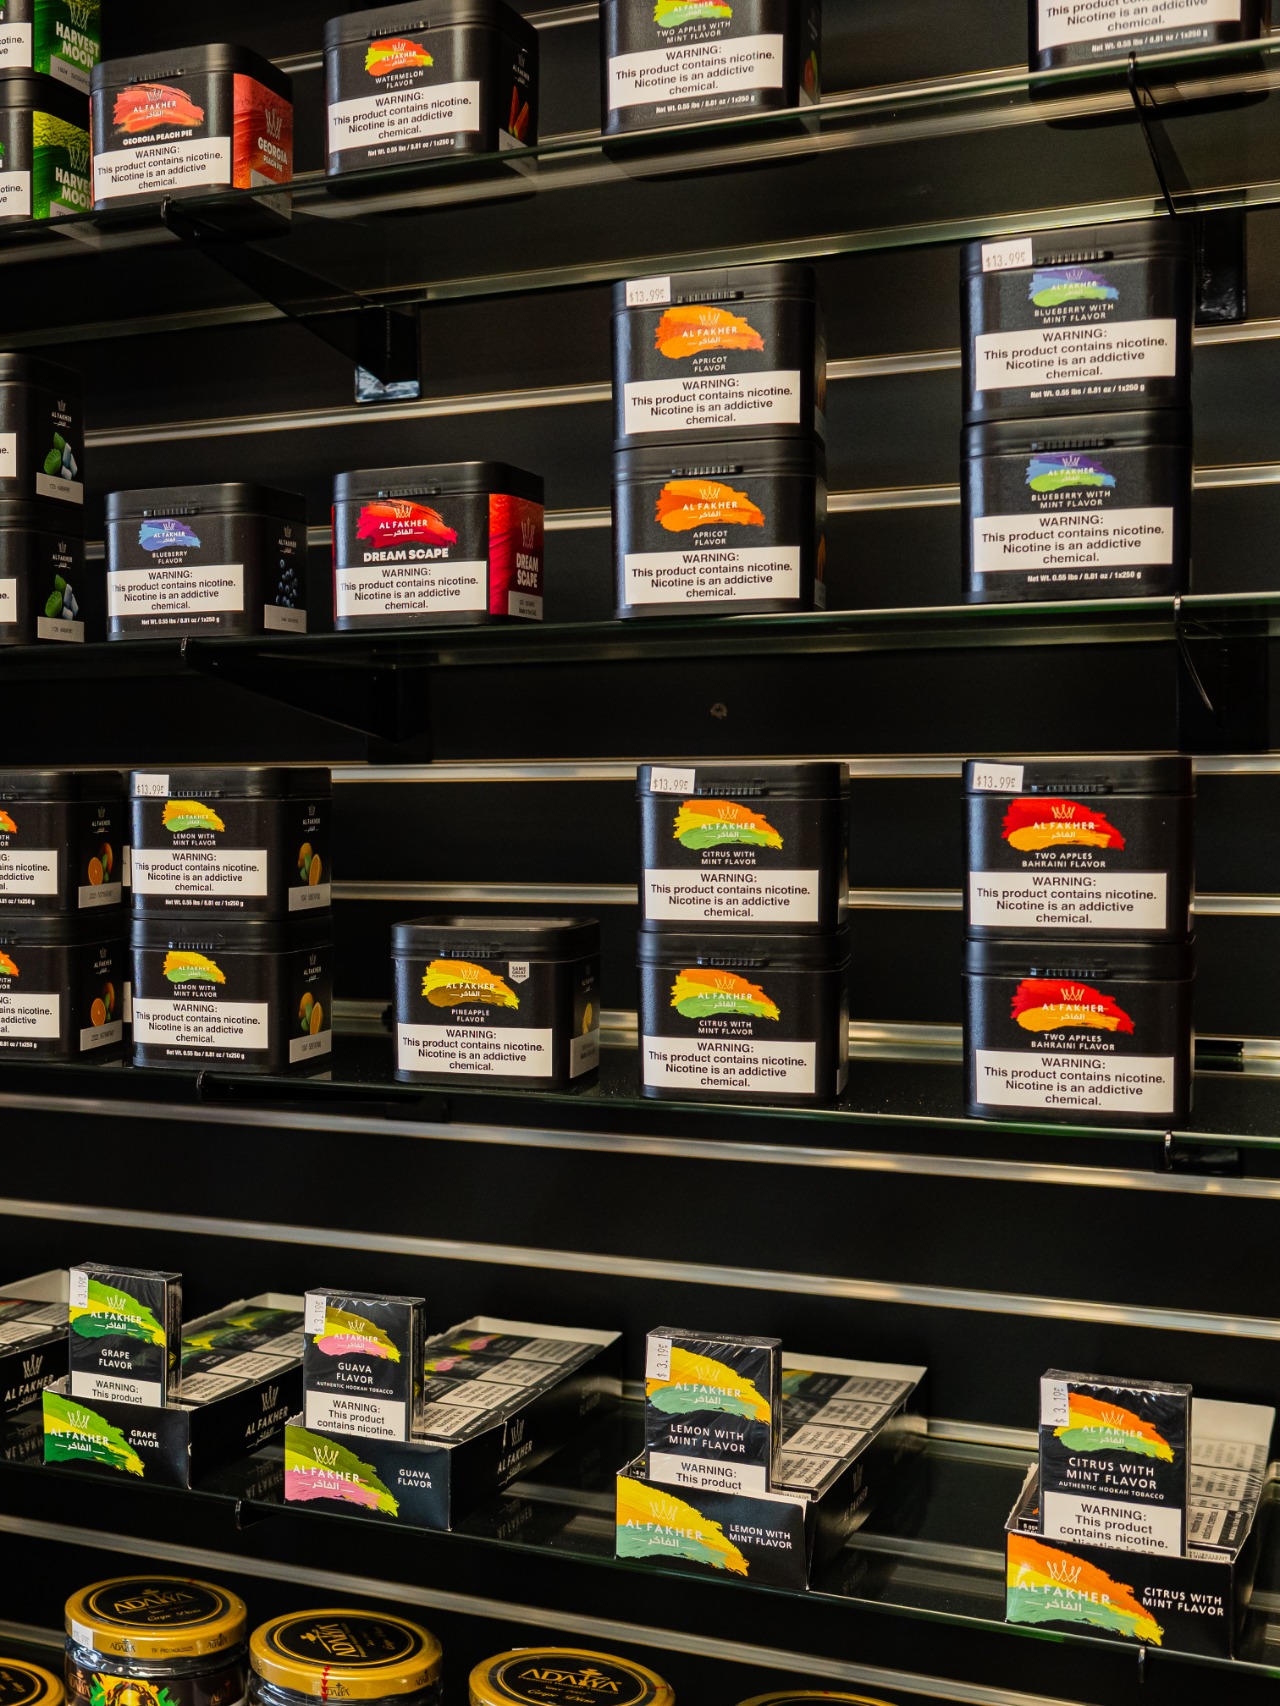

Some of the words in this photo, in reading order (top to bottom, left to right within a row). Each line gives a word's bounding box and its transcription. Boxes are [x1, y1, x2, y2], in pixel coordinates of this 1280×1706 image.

[657, 30, 675, 38] TWO
[678, 24, 707, 35] APPLES
[709, 21, 731, 30] WITH
[667, 35, 687, 43] MINT
[690, 30, 721, 40] FLAVOR
[56, 21, 99, 56] HARVEST
[62, 40, 93, 68] MOON
[375, 70, 423, 84] WATERMELON
[387, 79, 413, 89] FLAVOR
[123, 136, 155, 146] GEORGIA
[156, 131, 180, 141] PEACH
[181, 129, 192, 137] PIE
[1034, 305, 1085, 317] BLUEBERRY
[1089, 303, 1114, 311] WITH
[1043, 315, 1066, 324] MINT
[1070, 312, 1106, 322] FLAVOR
[682, 329, 694, 338] AL
[697, 326, 737, 335] FAKHER
[693, 356, 727, 365] APRICOT
[694, 364, 726, 372] FLAVOR
[364, 550, 407, 562] DREAM
[409, 548, 448, 559] SCAPE
[516, 553, 538, 570] DREAM
[517, 571, 538, 588] SCAPE
[1033, 877, 1096, 886] WARNING:
[977, 888, 998, 898] This
[1002, 889, 1047, 902] product
[1051, 889, 1101, 899] contains
[1105, 890, 1157, 900] nicotine.
[997, 901, 1044, 911] Nicotine
[1048, 902, 1058, 911] is
[1079, 902, 1134, 912] addictive
[1036, 914, 1092, 923] chemical.
[102, 1349, 130, 1359] GRAPE
[99, 1358, 132, 1370] FLAVOR
[338, 1362, 372, 1373] GUAVA
[336, 1373, 373, 1384] FLAVOR
[51, 1428, 63, 1437] AL
[66, 1431, 108, 1445] FAKHER
[131, 1430, 157, 1439] GRAPE
[671, 1424, 709, 1436] LEMON
[714, 1430, 744, 1441] WITH
[1082, 1425, 1096, 1433] AL
[1099, 1427, 1143, 1438] FAKHER
[129, 1438, 159, 1448] FLAVOR
[669, 1435, 697, 1447] MINT
[702, 1439, 745, 1453] FLAVOR
[293, 1465, 307, 1474] AL
[311, 1467, 359, 1483] FAKHER
[399, 1469, 430, 1479] GUAVA
[1069, 1458, 1114, 1471] CITRUS
[1120, 1464, 1154, 1476] WITH
[398, 1478, 432, 1488] FLAVOR
[1066, 1470, 1099, 1482] MINT
[1105, 1474, 1157, 1490] FLAVOR
[1059, 1481, 1096, 1491] AUTHENTIC
[1099, 1486, 1129, 1495] HOOKAH
[1131, 1490, 1164, 1500] TOBACCO
[1081, 1503, 1147, 1521] WARNING:
[626, 1519, 642, 1530] AL
[647, 1523, 703, 1540] FAKHER
[730, 1524, 763, 1536] LEMON
[766, 1530, 791, 1540] WITH
[1075, 1514, 1101, 1527] This
[1104, 1518, 1152, 1535] product
[729, 1533, 753, 1544] MINT
[756, 1537, 792, 1549] FLAVOR
[1060, 1525, 1111, 1541] contains
[1115, 1531, 1168, 1548] nicotine.
[1019, 1582, 1038, 1593] AL
[1043, 1584, 1110, 1605] FAKHER
[1144, 1587, 1186, 1600] CITRUS
[1190, 1593, 1222, 1605] WITH
[1143, 1597, 1173, 1609] MINT
[1178, 1601, 1224, 1616] FLAVOR
